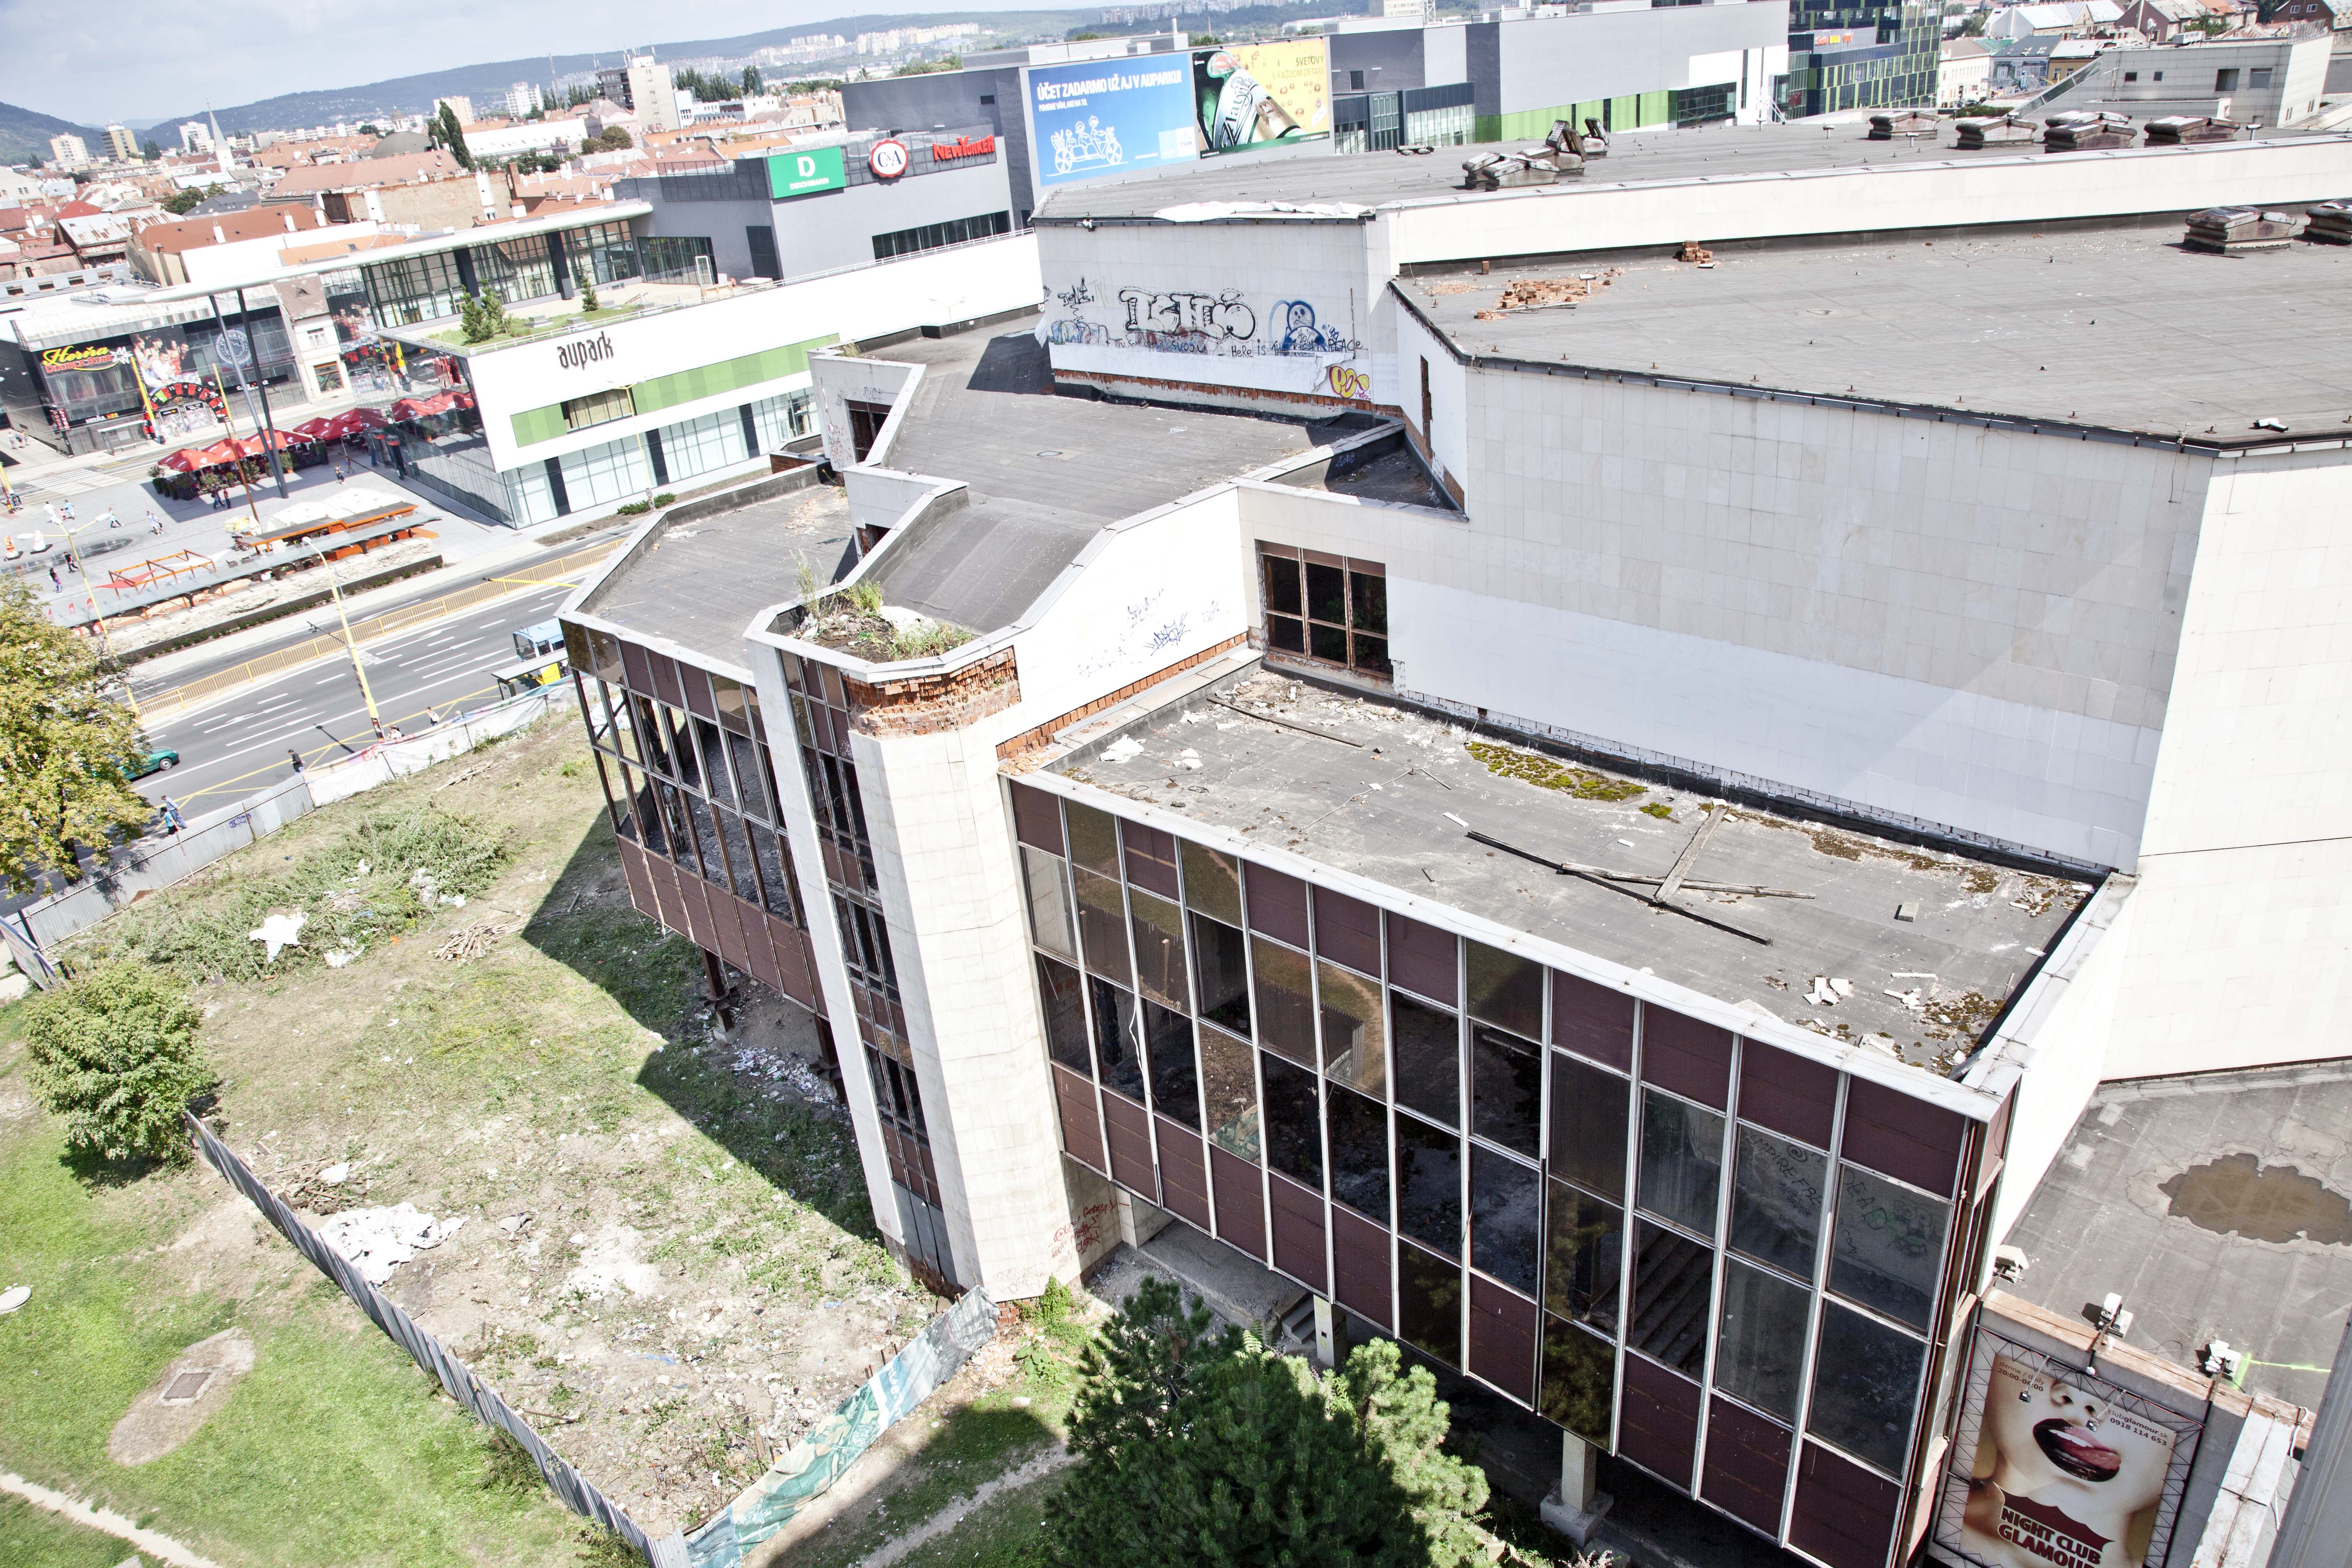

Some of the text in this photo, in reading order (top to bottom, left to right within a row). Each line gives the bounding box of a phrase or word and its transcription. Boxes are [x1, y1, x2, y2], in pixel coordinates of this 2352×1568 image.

[1296, 54, 1324, 66] SVETOVÝ
[1277, 68, 1302, 78] KAŽDOM
[1304, 66, 1324, 76] DETAILE
[1037, 70, 1182, 101] ÚČET ZADARMO UŽ AJ V AUPARKU!
[797, 156, 816, 178] D
[877, 150, 903, 168] C&A
[789, 177, 829, 190] DEICHMANN
[42, 346, 110, 366] Herňa
[87, 355, 112, 365] STAR
[557, 331, 614, 371] aupark
[1999, 1362, 2022, 1374] denne
[2108, 1409, 2169, 1439] clubglamour.sk
[2110, 1417, 2167, 1446] 0918 114 653
[2000, 1507, 2102, 1565] NIGHT CLUB
